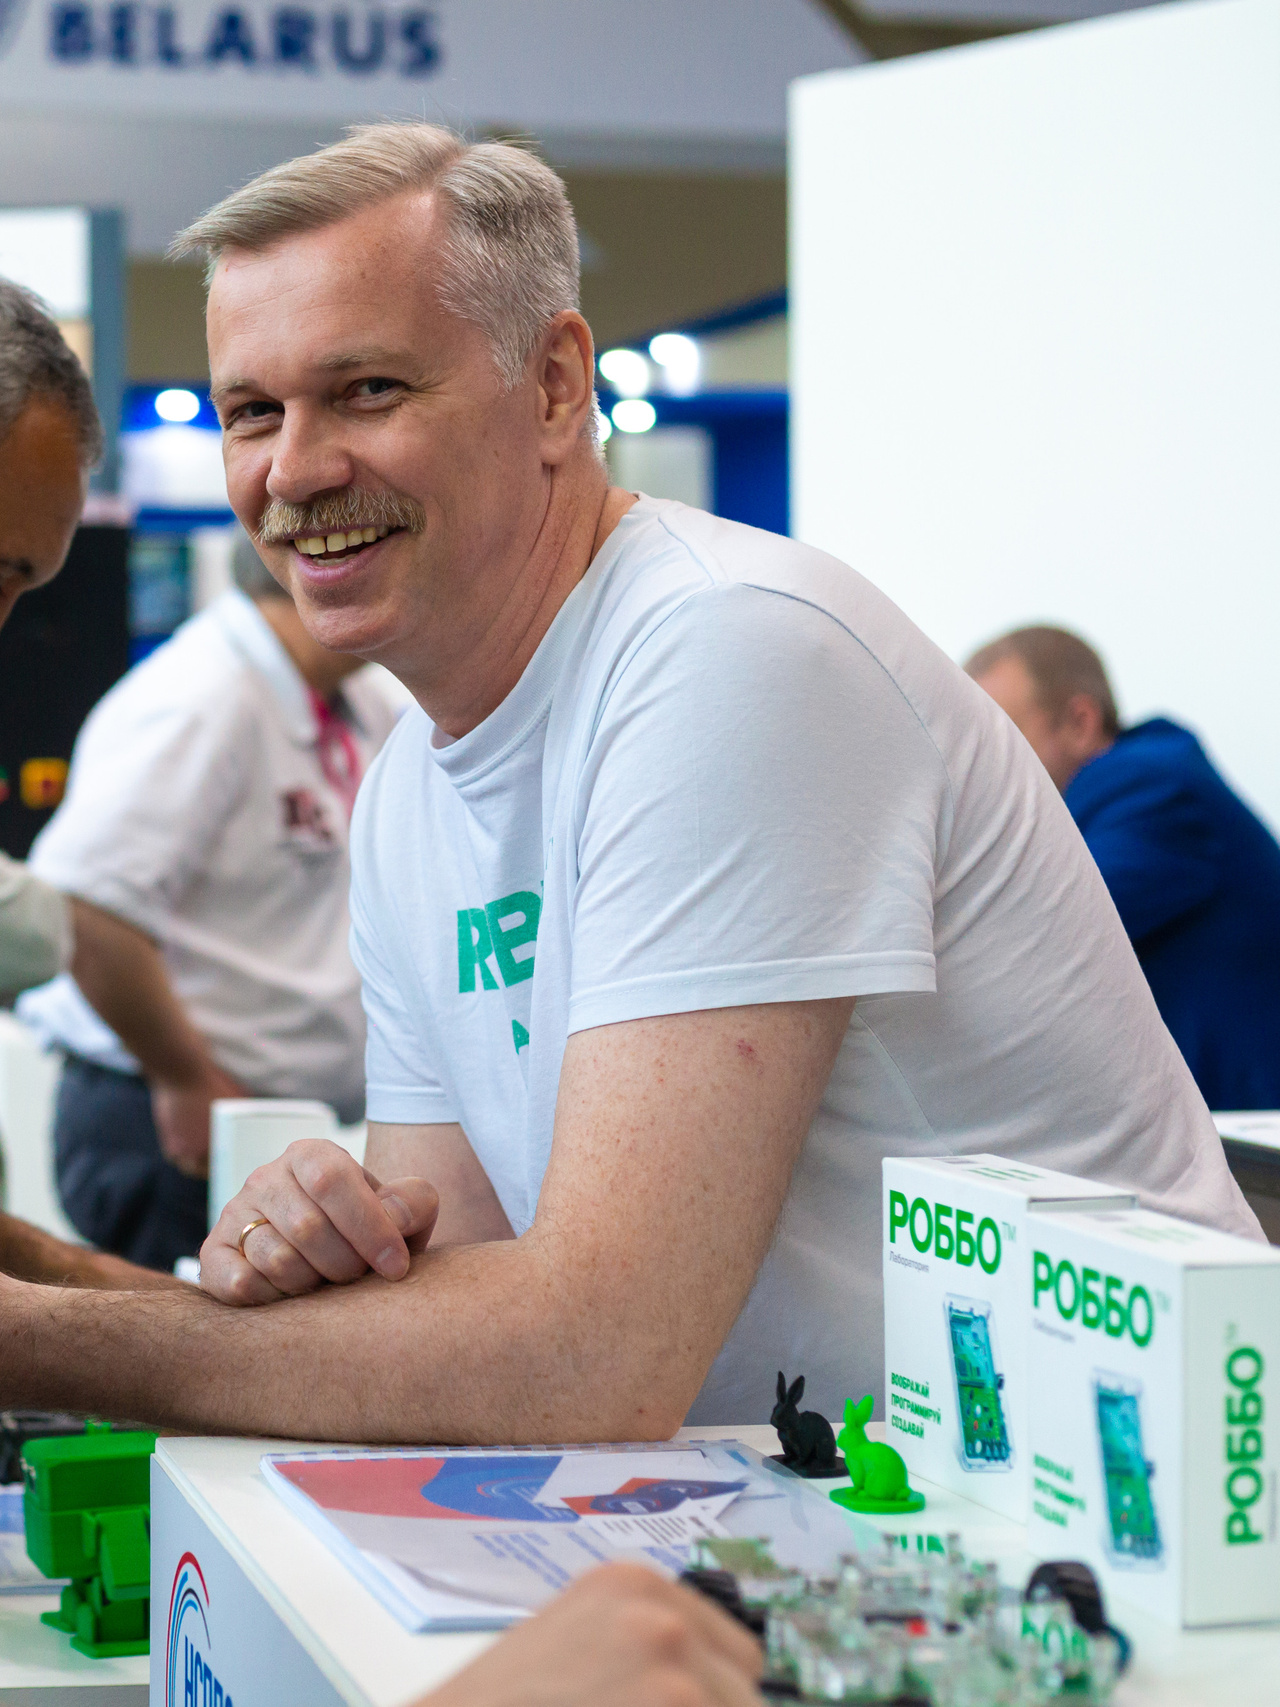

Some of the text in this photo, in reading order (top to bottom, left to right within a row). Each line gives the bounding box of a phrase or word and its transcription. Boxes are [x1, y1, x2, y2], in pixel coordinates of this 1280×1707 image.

[48, 2, 442, 79] BELARUS
[889, 1189, 1002, 1275] РОББО
[1033, 1250, 1154, 1348] РОББО
[1225, 1346, 1264, 1545] РОББО
